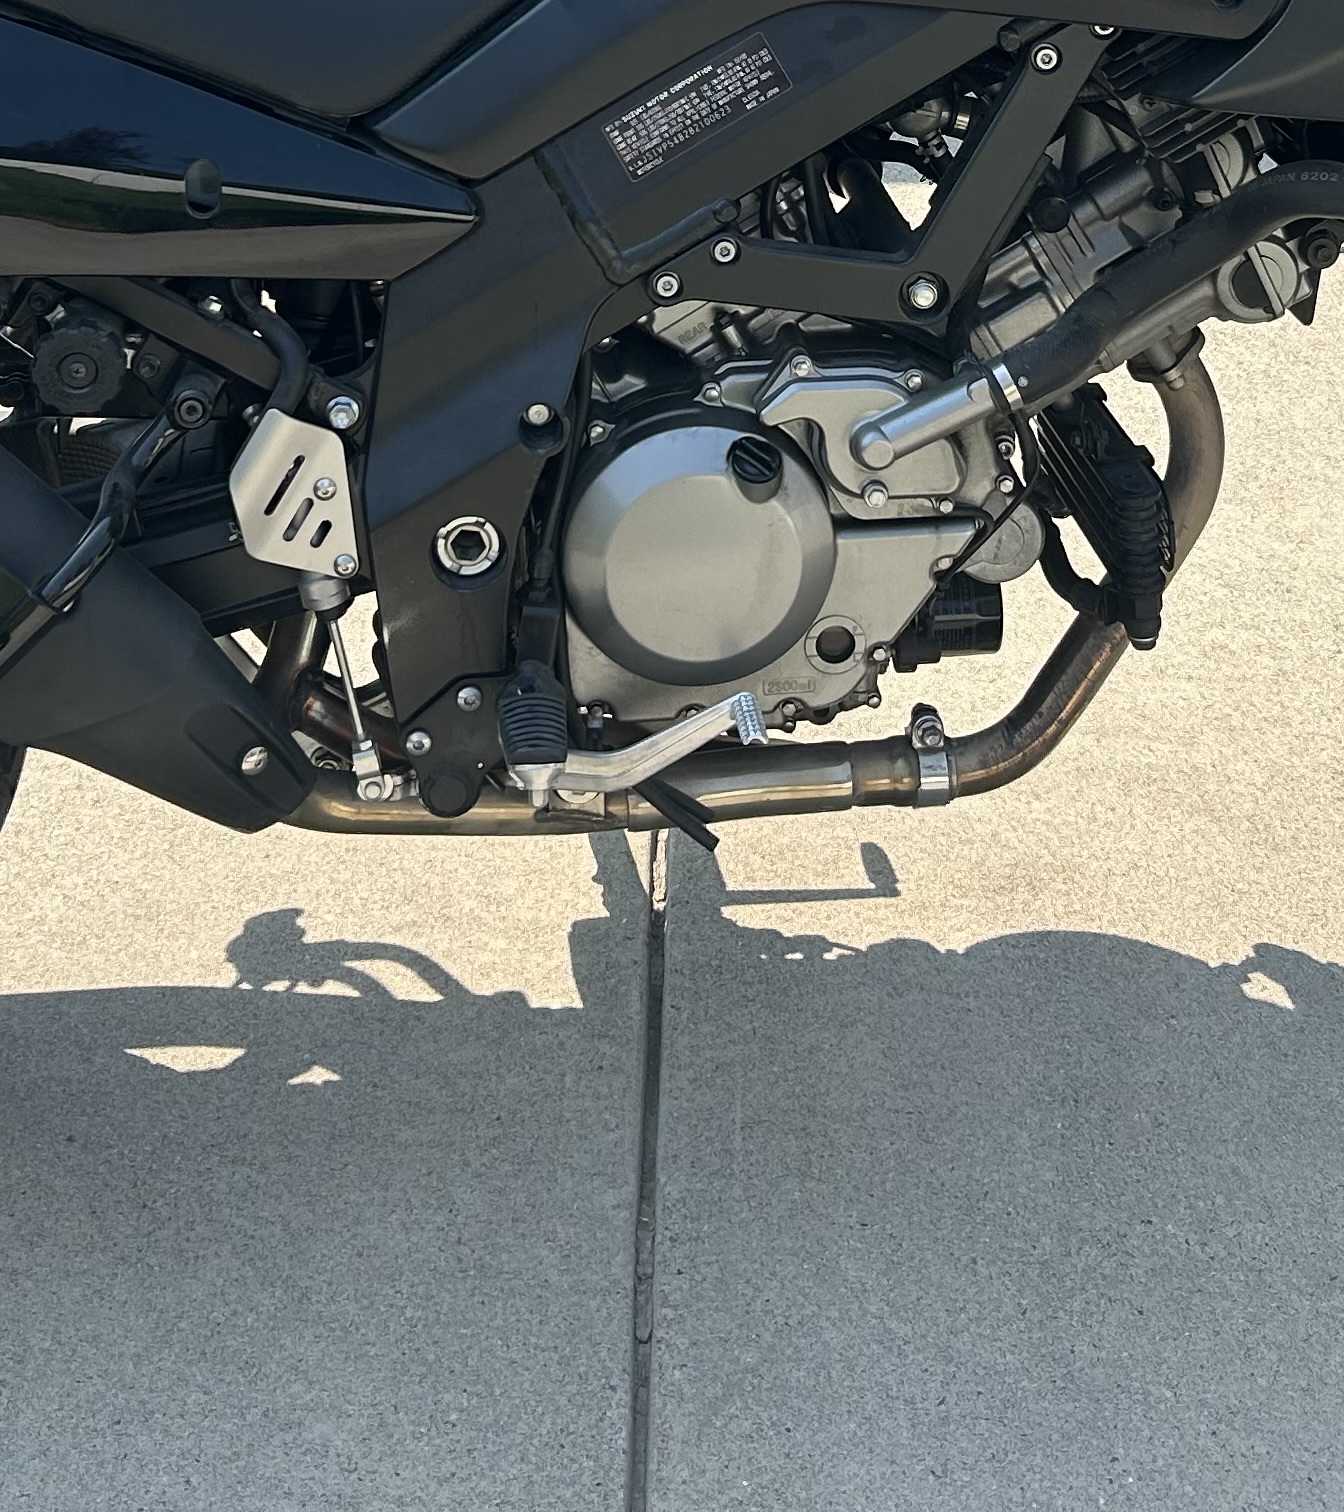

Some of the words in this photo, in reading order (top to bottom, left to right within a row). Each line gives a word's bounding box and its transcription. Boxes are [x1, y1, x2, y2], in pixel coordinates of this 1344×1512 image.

[622, 105, 647, 123] SUZUKI
[670, 64, 714, 94] CORPORATION
[678, 322, 708, 345] REAR
